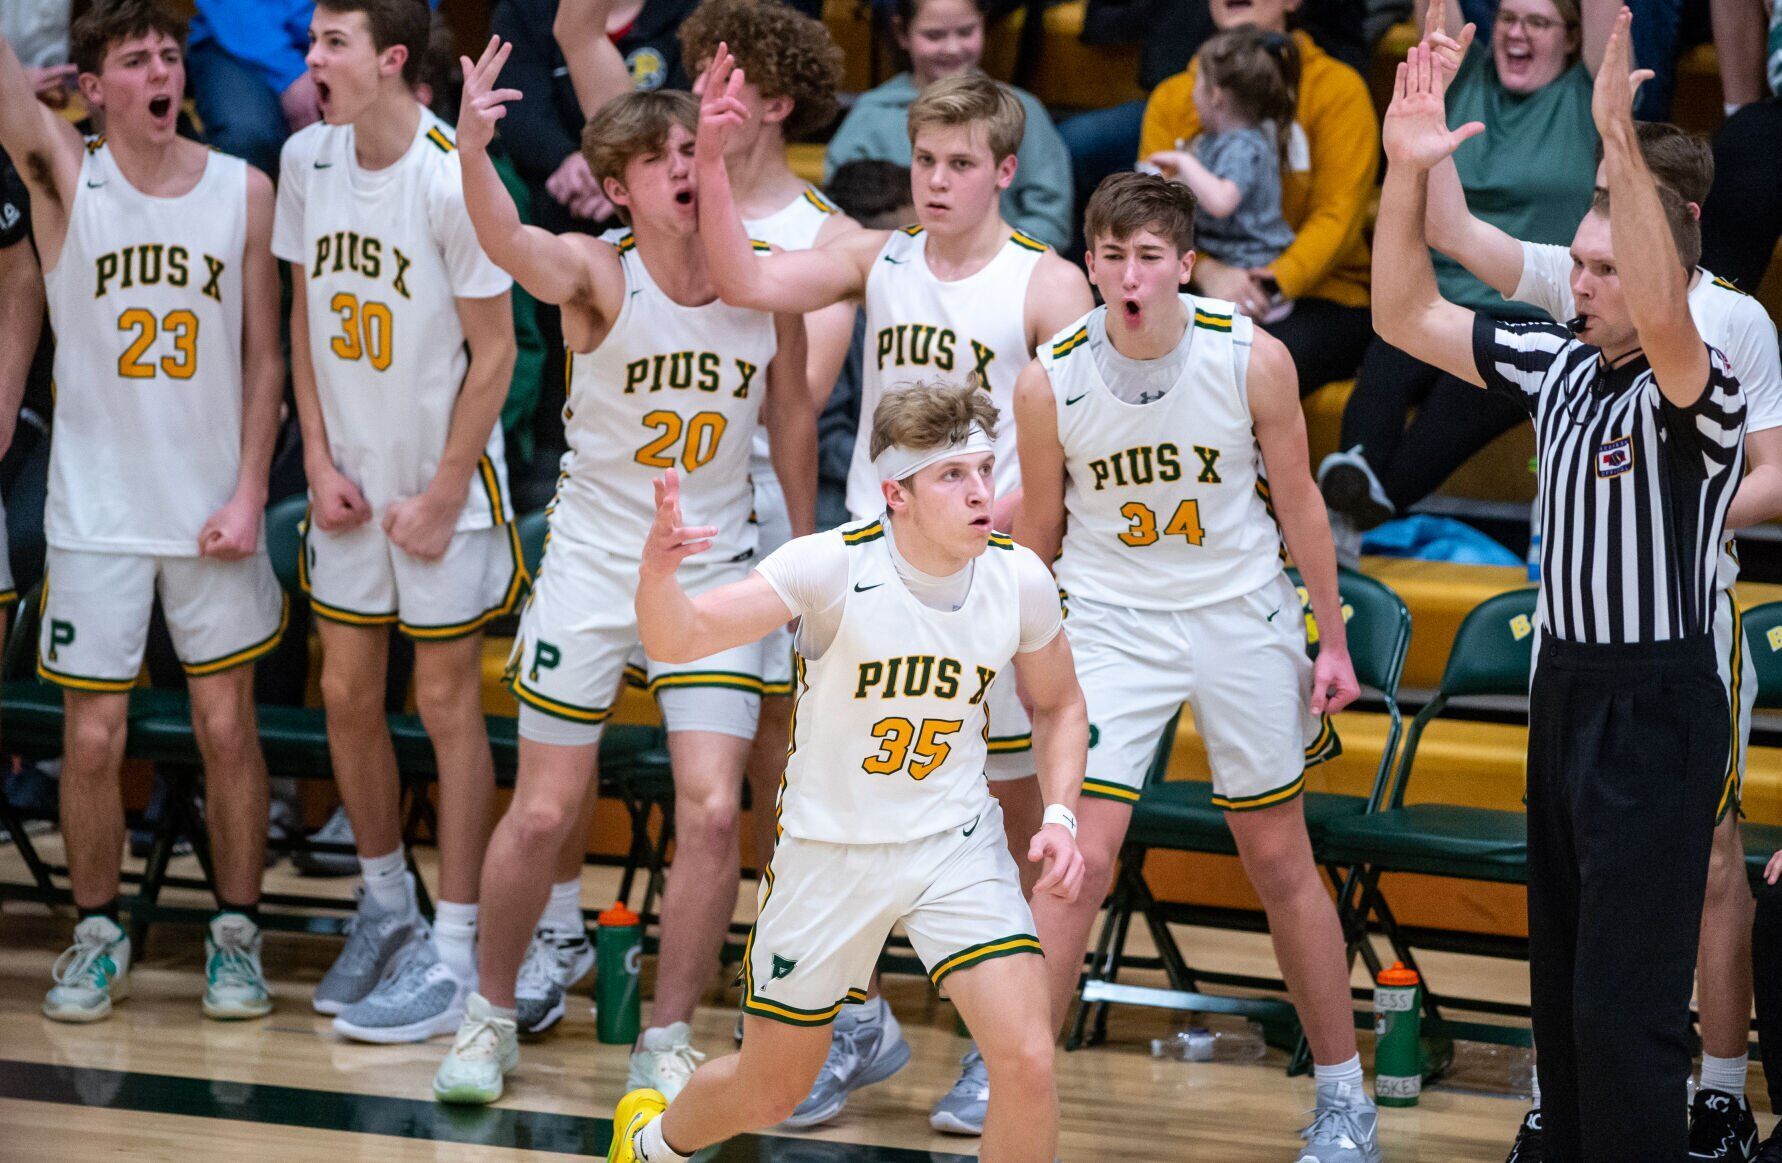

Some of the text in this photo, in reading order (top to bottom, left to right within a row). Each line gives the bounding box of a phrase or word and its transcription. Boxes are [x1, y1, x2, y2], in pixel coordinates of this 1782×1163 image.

[95, 243, 225, 304] PIUS X
[311, 230, 411, 301] PIUS X
[117, 306, 199, 380] 23
[330, 291, 393, 373] 30
[877, 323, 995, 394] PIUS X
[623, 350, 757, 399] PIUS X
[633, 409, 728, 474] 20
[1088, 442, 1222, 491] PIUS X
[1117, 498, 1206, 548] 34
[48, 618, 76, 662] P
[529, 638, 562, 684] P
[854, 656, 997, 705] PIUS X
[861, 716, 965, 781] 35
